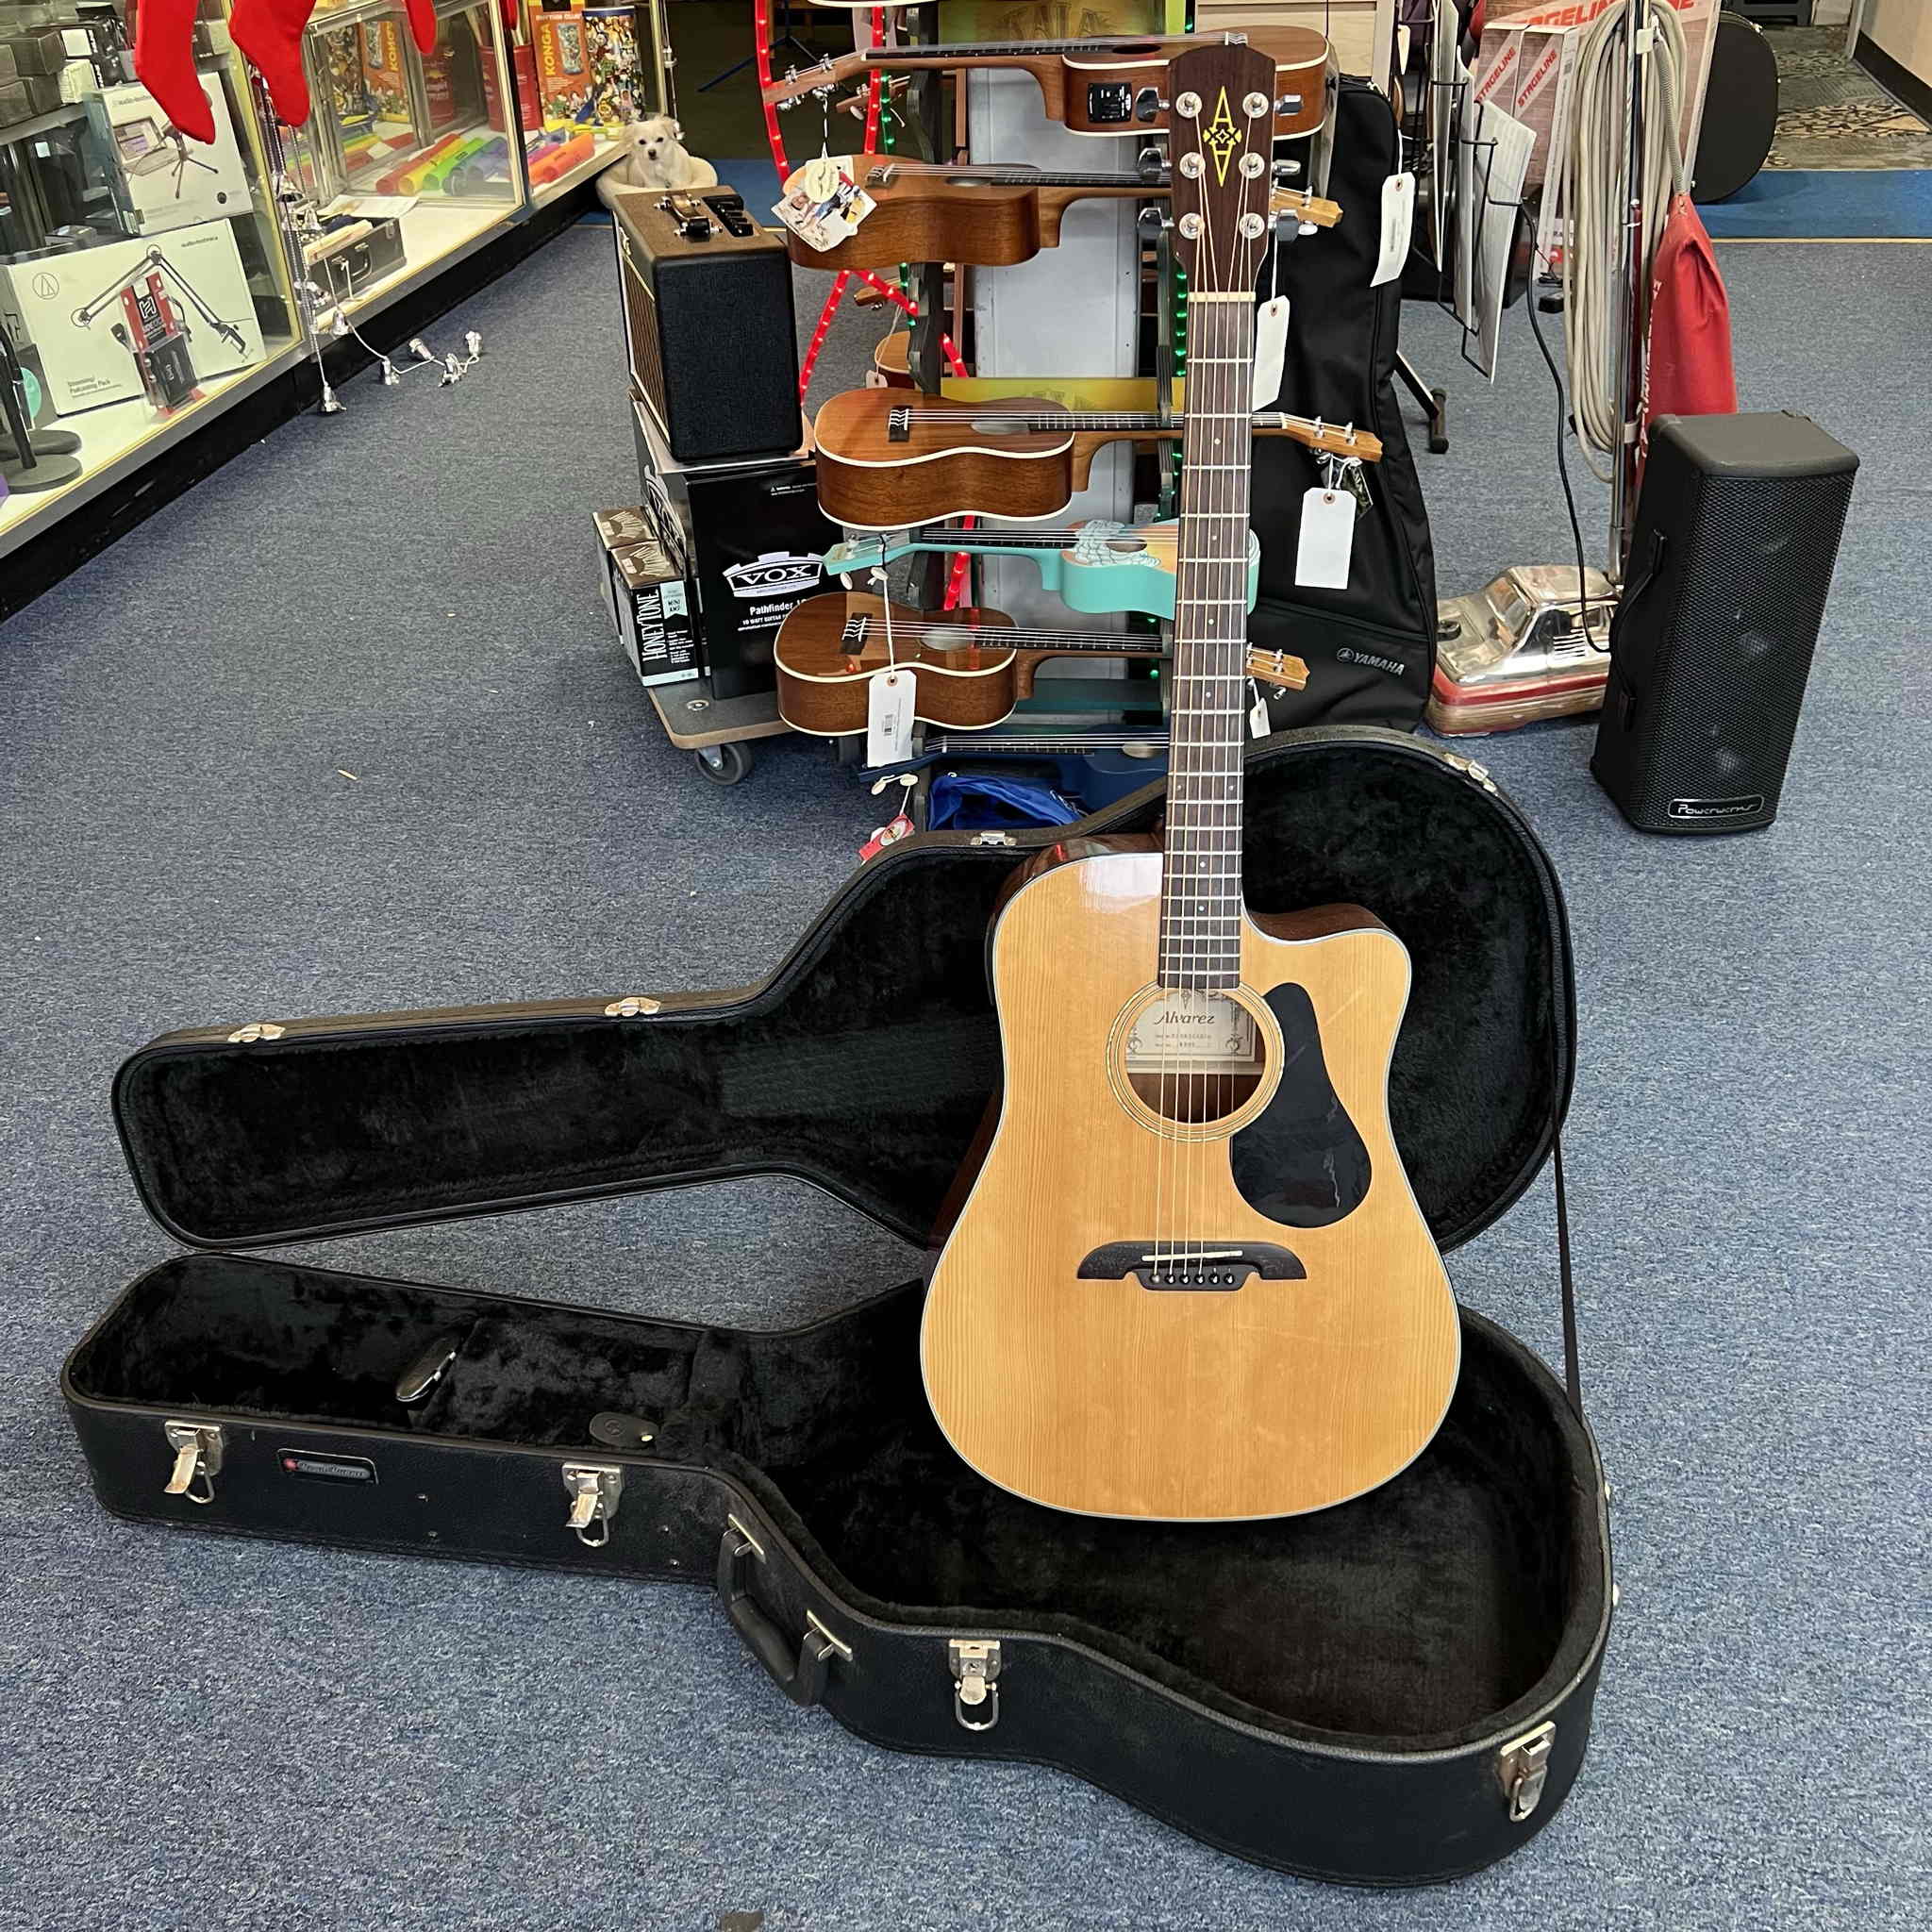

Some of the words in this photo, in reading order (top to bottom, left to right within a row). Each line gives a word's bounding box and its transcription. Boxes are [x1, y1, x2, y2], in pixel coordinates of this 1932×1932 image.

[541, 23, 556, 75] KONGA
[1518, 49, 1557, 108] STAGELINE
[736, 565, 812, 585] VOX
[749, 602, 794, 616] Pathfinder
[636, 588, 668, 661] HONEYTONE
[1354, 653, 1405, 675] YAMAHA
[1154, 1010, 1215, 1024] Alvarez
